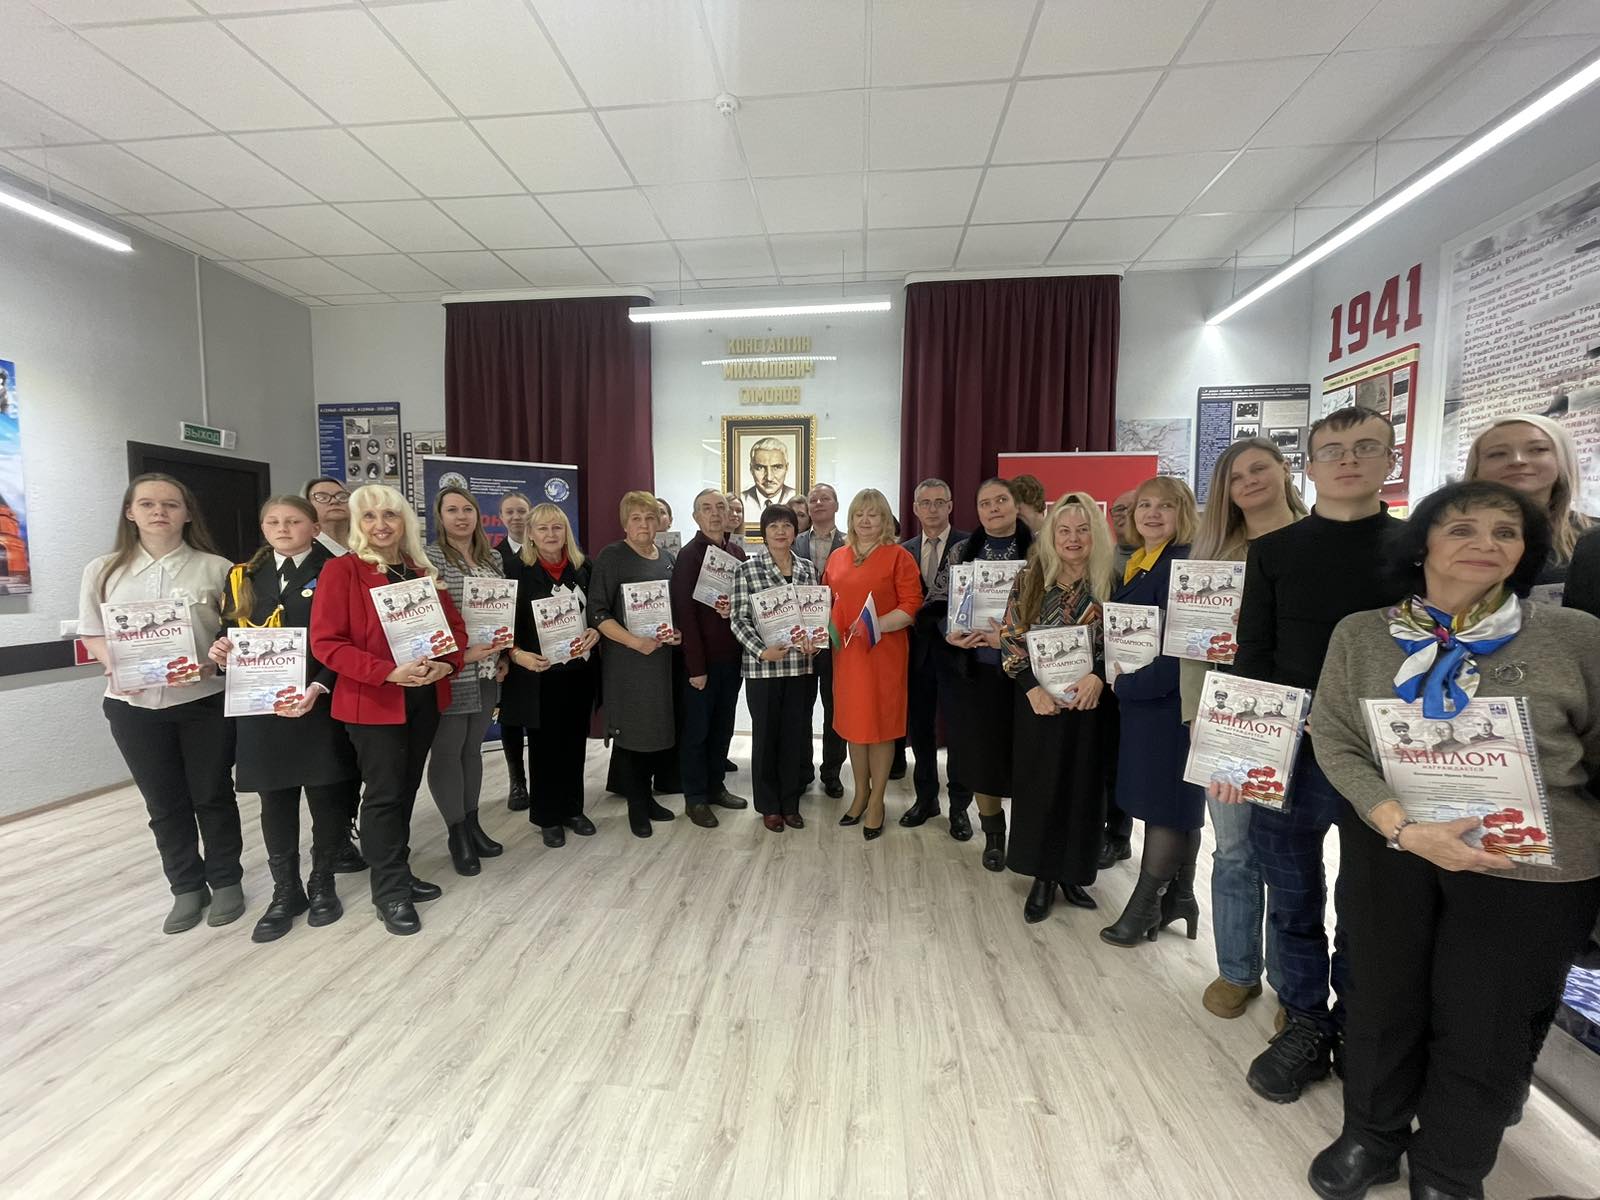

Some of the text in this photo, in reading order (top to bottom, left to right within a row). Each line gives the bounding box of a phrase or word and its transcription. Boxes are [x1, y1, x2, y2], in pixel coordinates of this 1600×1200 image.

[1328, 263, 1423, 363] 1941
[728, 336, 811, 354] КОНСТАНТИН
[740, 387, 801, 405] СИМОНОВ
[184, 427, 220, 444] ВЫХОД
[631, 602, 665, 611] ДИПЛОМ
[1176, 592, 1233, 607] ДИПЛОМ
[388, 604, 434, 622] ДИПЛОМ
[543, 615, 577, 629] ДИПЛОМ
[117, 627, 182, 641] ДИПЛОМ
[1108, 636, 1153, 647] БЛАГОДАРНОСТЬ
[237, 657, 296, 667] ДИПЛОМ
[1039, 658, 1087, 668] БЛАГОДАРНОСТЬ
[1209, 710, 1282, 737] ДИПЛОМ
[1399, 748, 1508, 767] ДИПЛОМ
